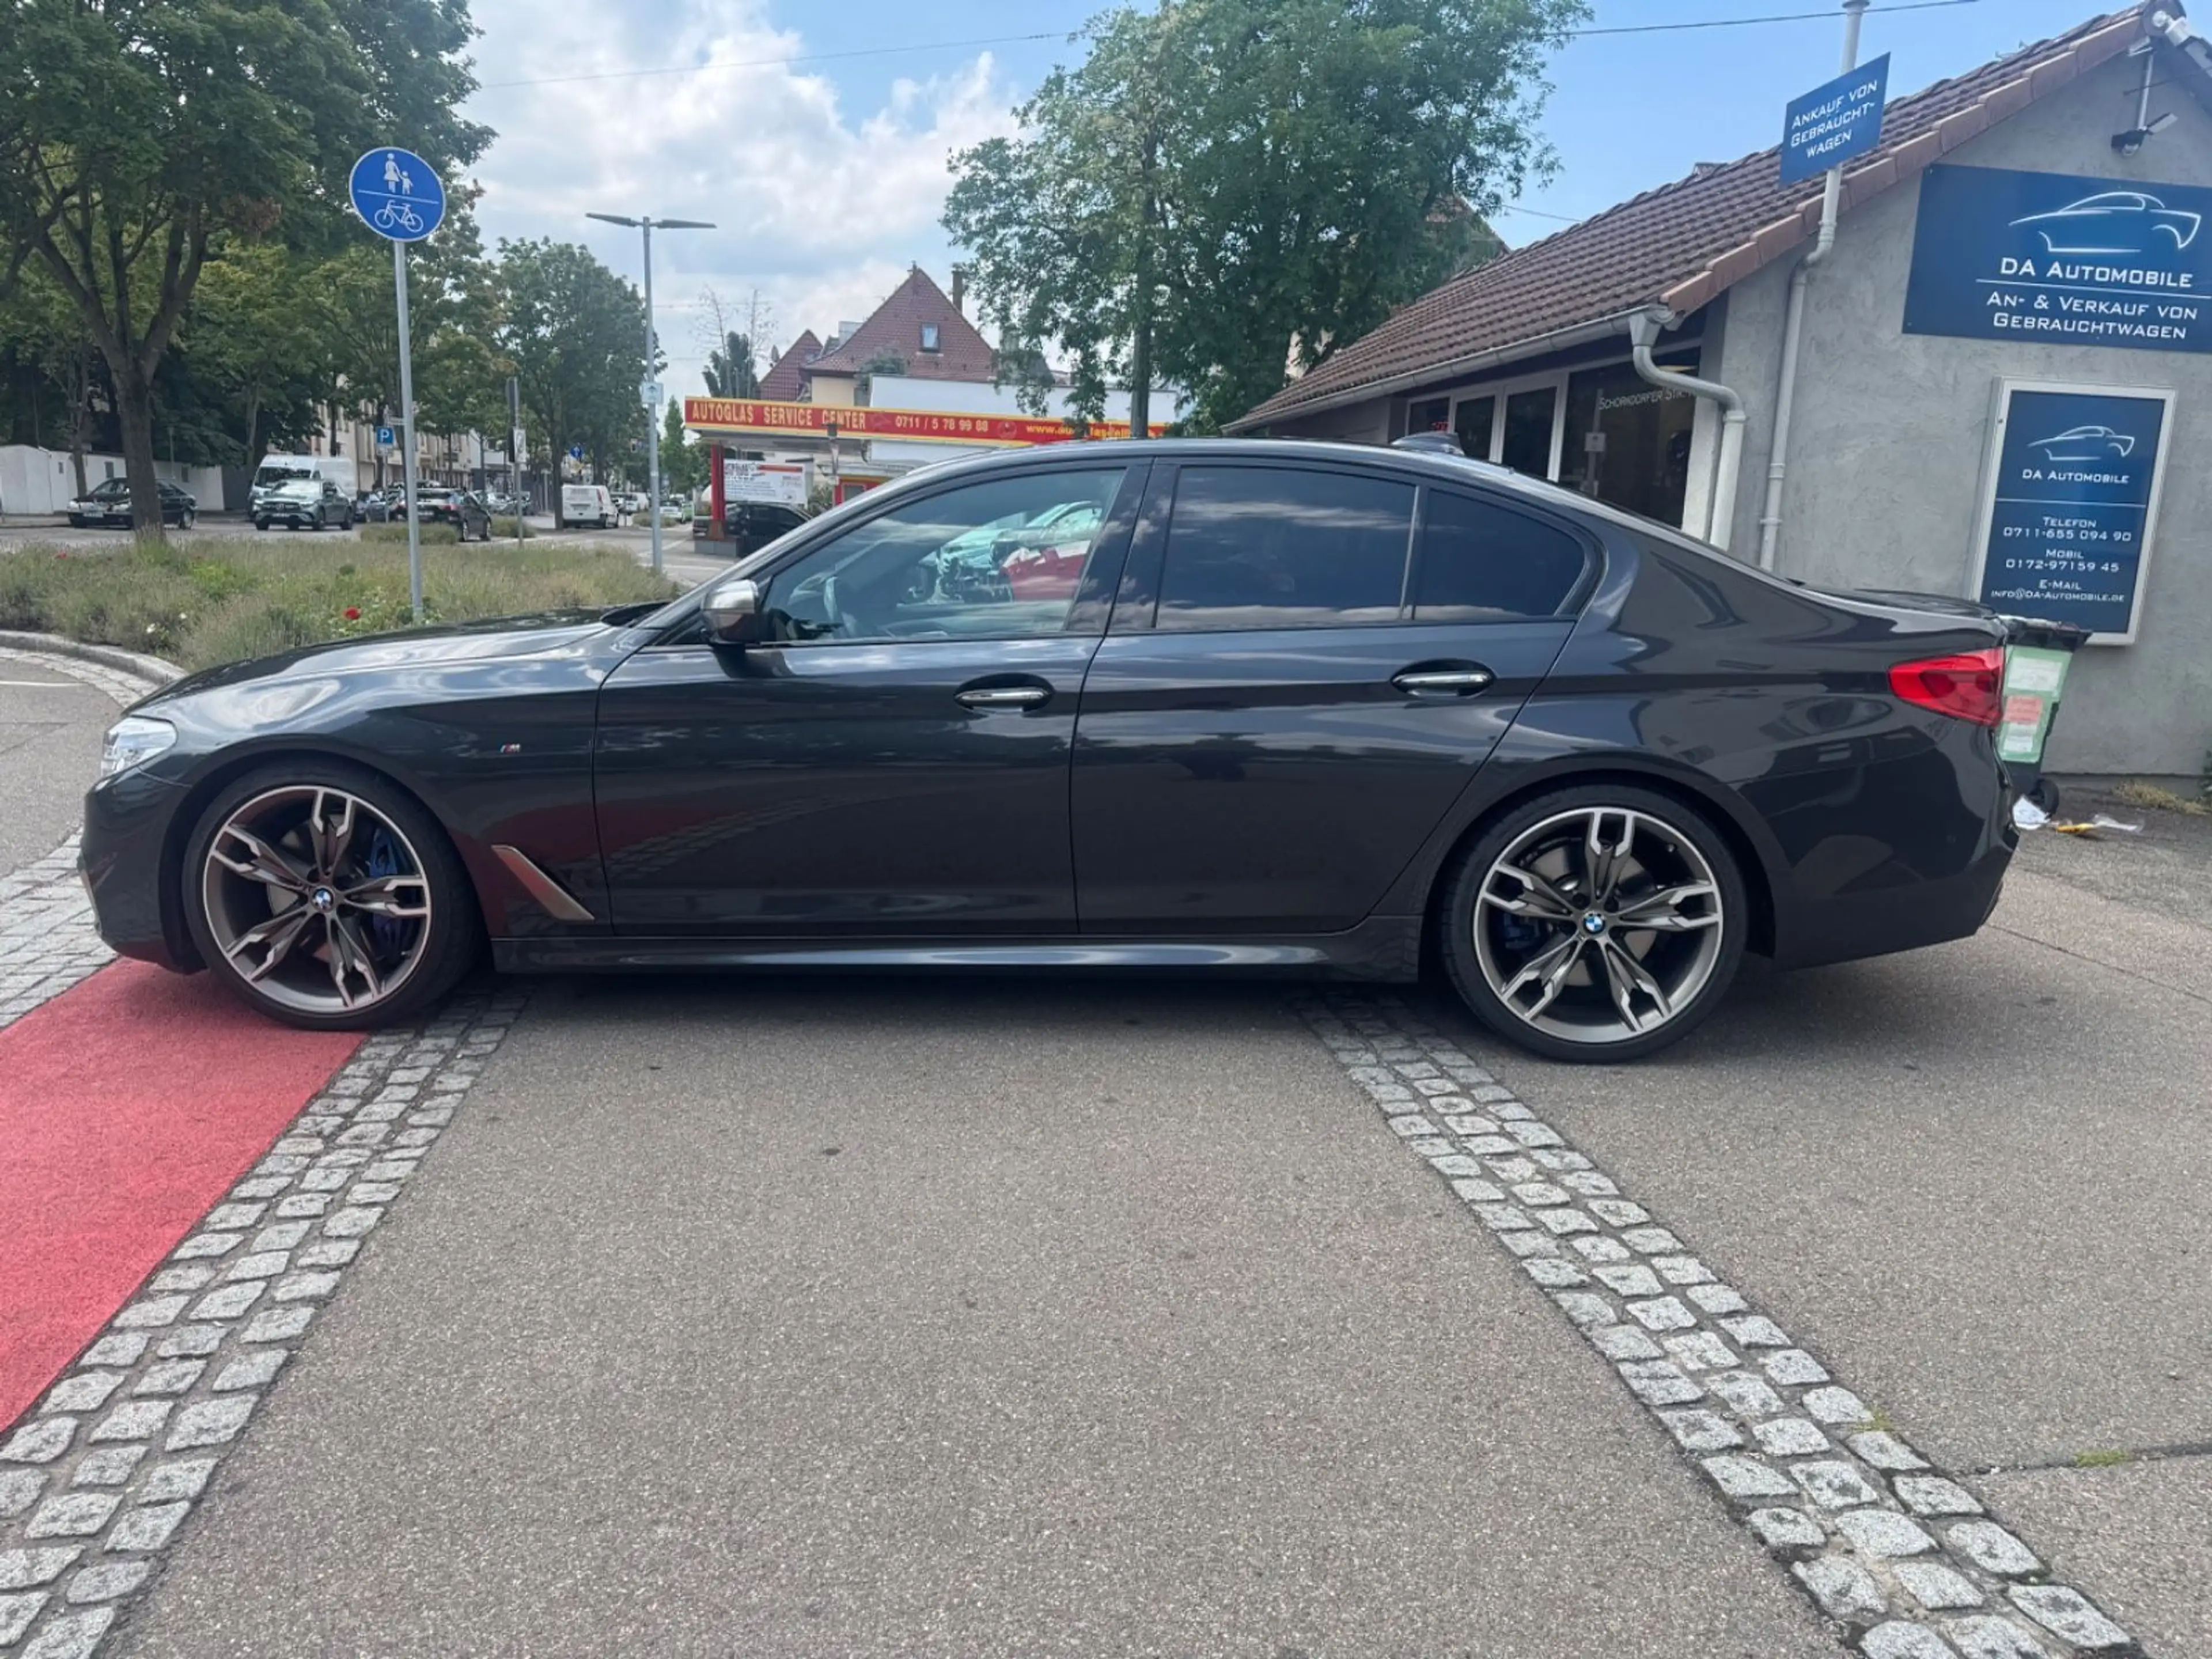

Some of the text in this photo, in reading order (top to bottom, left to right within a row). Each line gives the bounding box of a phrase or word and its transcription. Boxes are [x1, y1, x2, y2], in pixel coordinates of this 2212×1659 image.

[1791, 79, 1877, 130] ANKAUF VON
[1790, 102, 1875, 148] GEBRAUCHT-
[1805, 129, 1852, 158] WAGEN
[2000, 257, 2193, 288] DA AUTOMOBILE
[1986, 291, 2198, 320] AN- & VERKAUF VON
[1993, 312, 2187, 339] GEBRAUCHTWAGEN
[692, 402, 753, 423] AUTOGLAS
[763, 406, 812, 426] SERVICE
[822, 410, 865, 429] CENTER
[2022, 469, 2130, 484] DA AUTOMOBILE
[2043, 516, 2097, 528] TELEFON
[2080, 531, 2108, 541] 094
[2113, 532, 2132, 541] 90
[2046, 548, 2085, 559] MOBIL
[2039, 579, 2082, 590] E-MAIL
